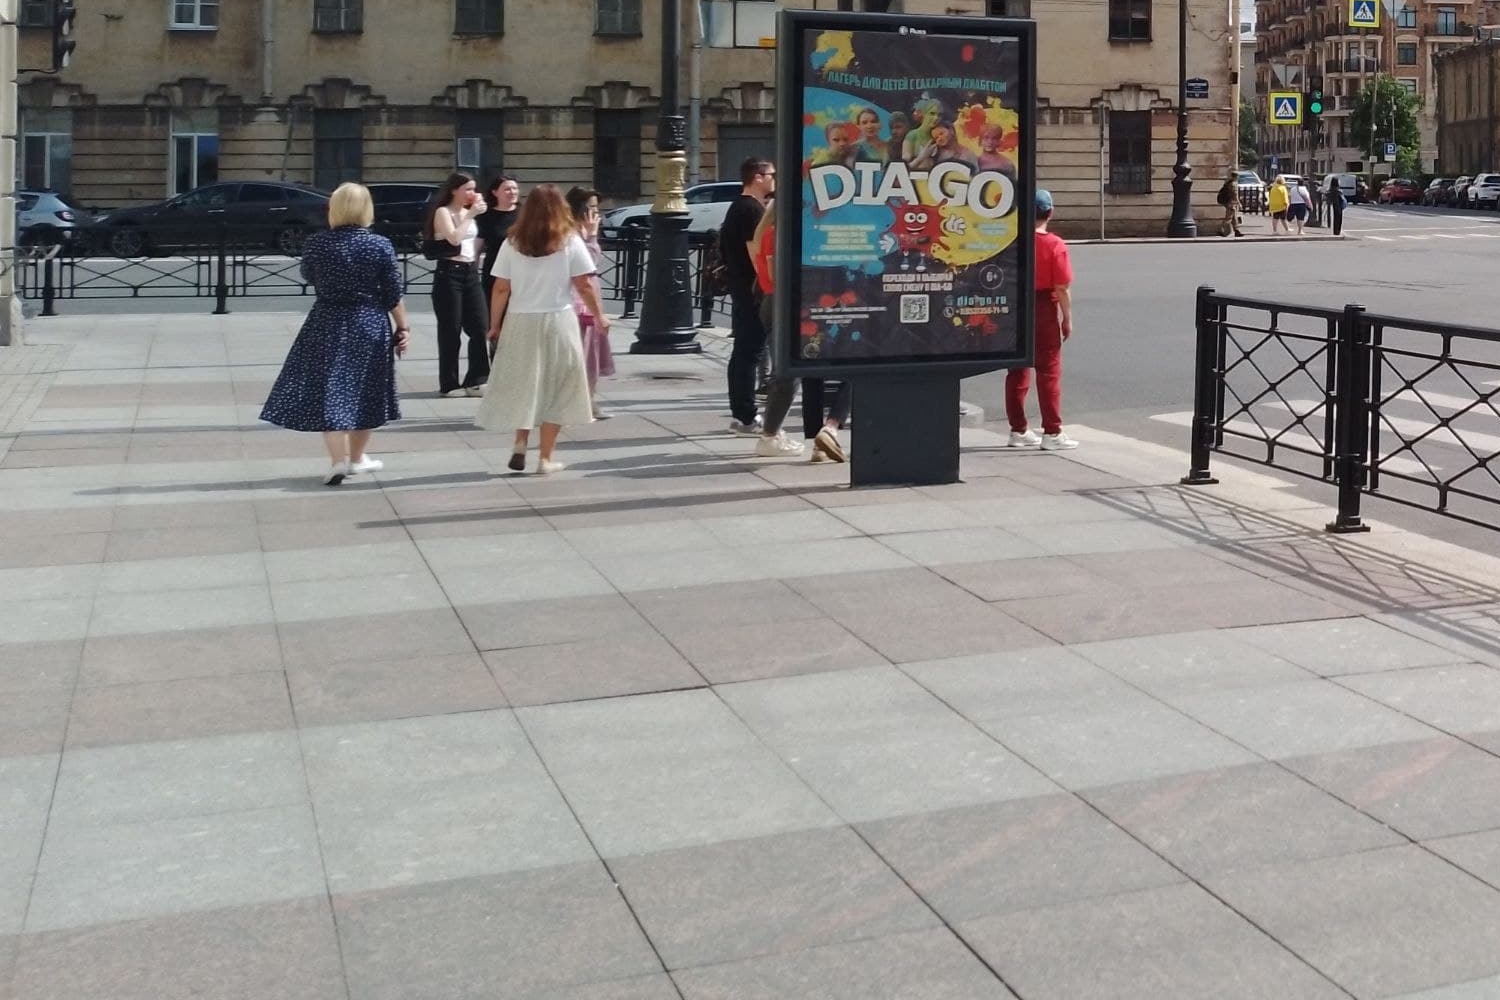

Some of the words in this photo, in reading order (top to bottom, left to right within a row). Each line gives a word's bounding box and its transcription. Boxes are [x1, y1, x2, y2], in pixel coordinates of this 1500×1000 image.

[828, 71, 861, 88] ЛАГЕРЬ
[862, 75, 881, 90] ДЛЯ
[882, 77, 909, 91] ДЕТЕЙ
[914, 77, 962, 91] САХАРНЫМ
[962, 78, 1007, 93] ДИАБЕТОМ
[809, 160, 1015, 219] DIA-GO
